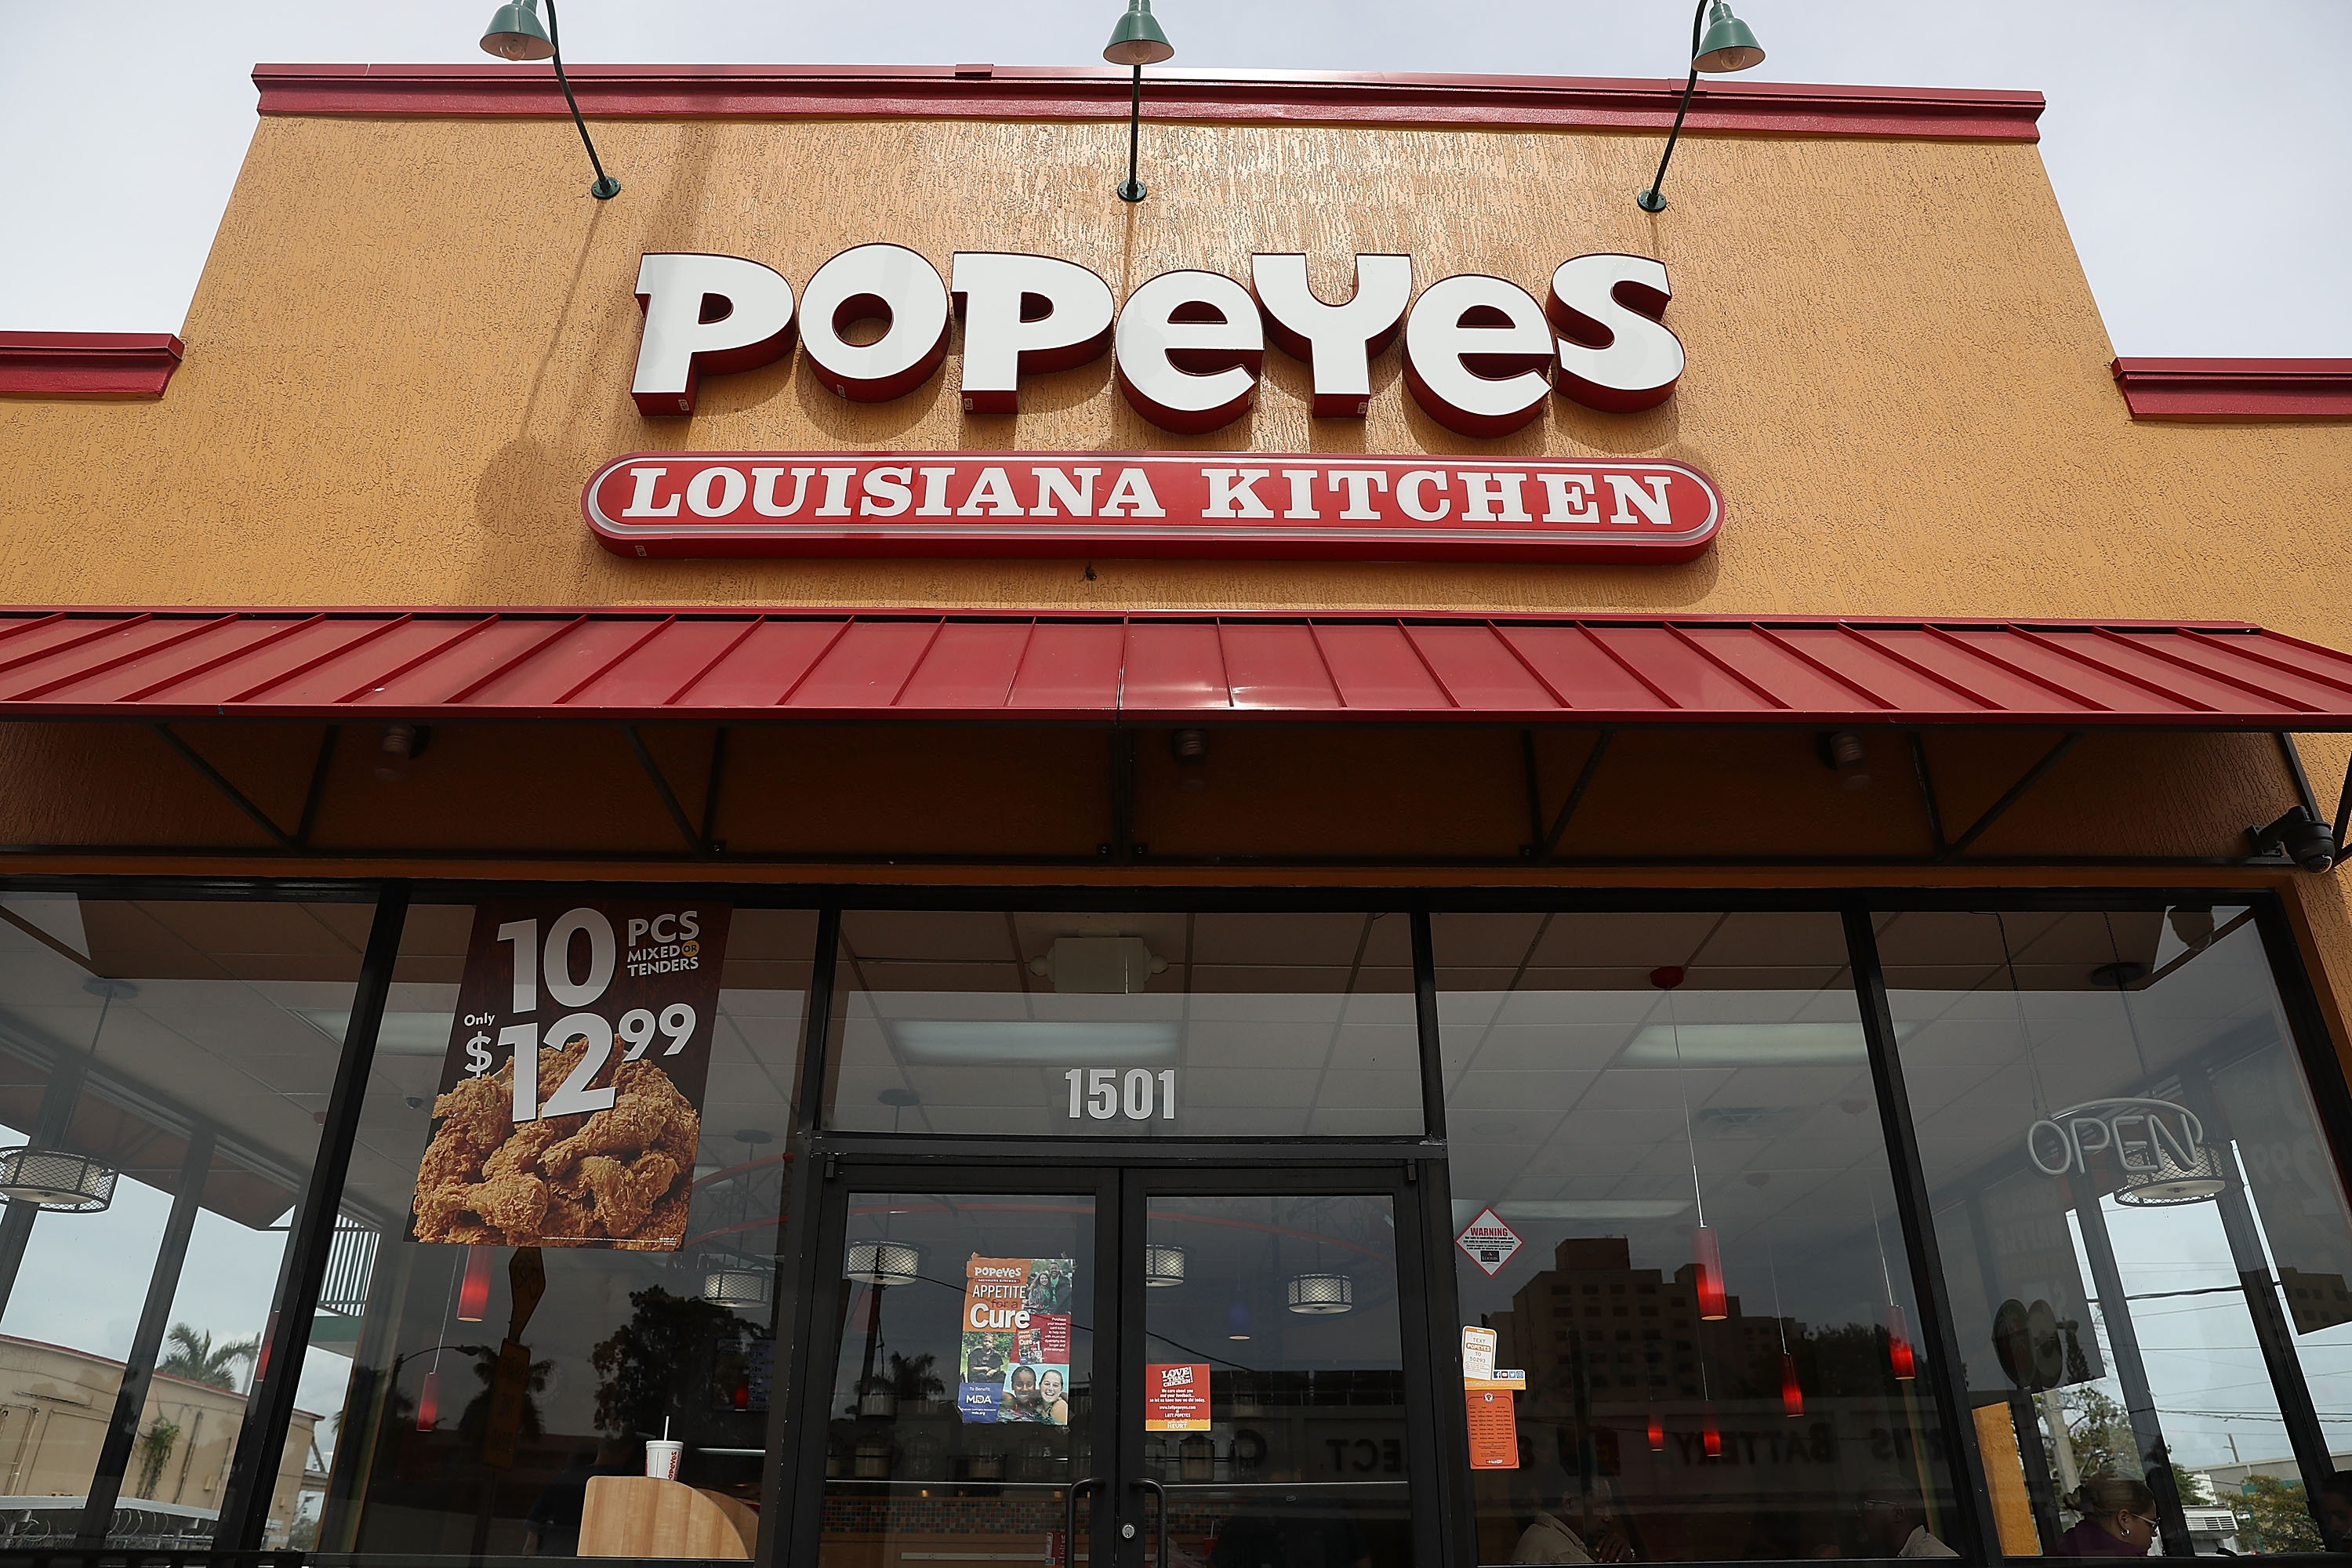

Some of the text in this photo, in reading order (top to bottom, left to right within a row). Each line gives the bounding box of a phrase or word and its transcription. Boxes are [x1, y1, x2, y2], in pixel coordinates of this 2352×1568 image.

[621, 467, 1672, 525] LOUISIANA KITCHEN
[628, 911, 699, 946] PCS
[497, 908, 615, 1013] 10
[627, 944, 698, 963] MIXED OR
[627, 956, 699, 977] TENDERS
[464, 1012, 495, 1026] Only
[1065, 1068, 1174, 1120] 1501
[2027, 1113, 2198, 1175] OPEN
[1470, 1227, 1508, 1236] WARNING
[972, 1285, 1027, 1298] APPETITE
[991, 1299, 1008, 1308] for
[970, 1302, 1030, 1329] Cure
[1161, 1367, 1189, 1378] LOVE
[966, 1395, 992, 1403] MDA
